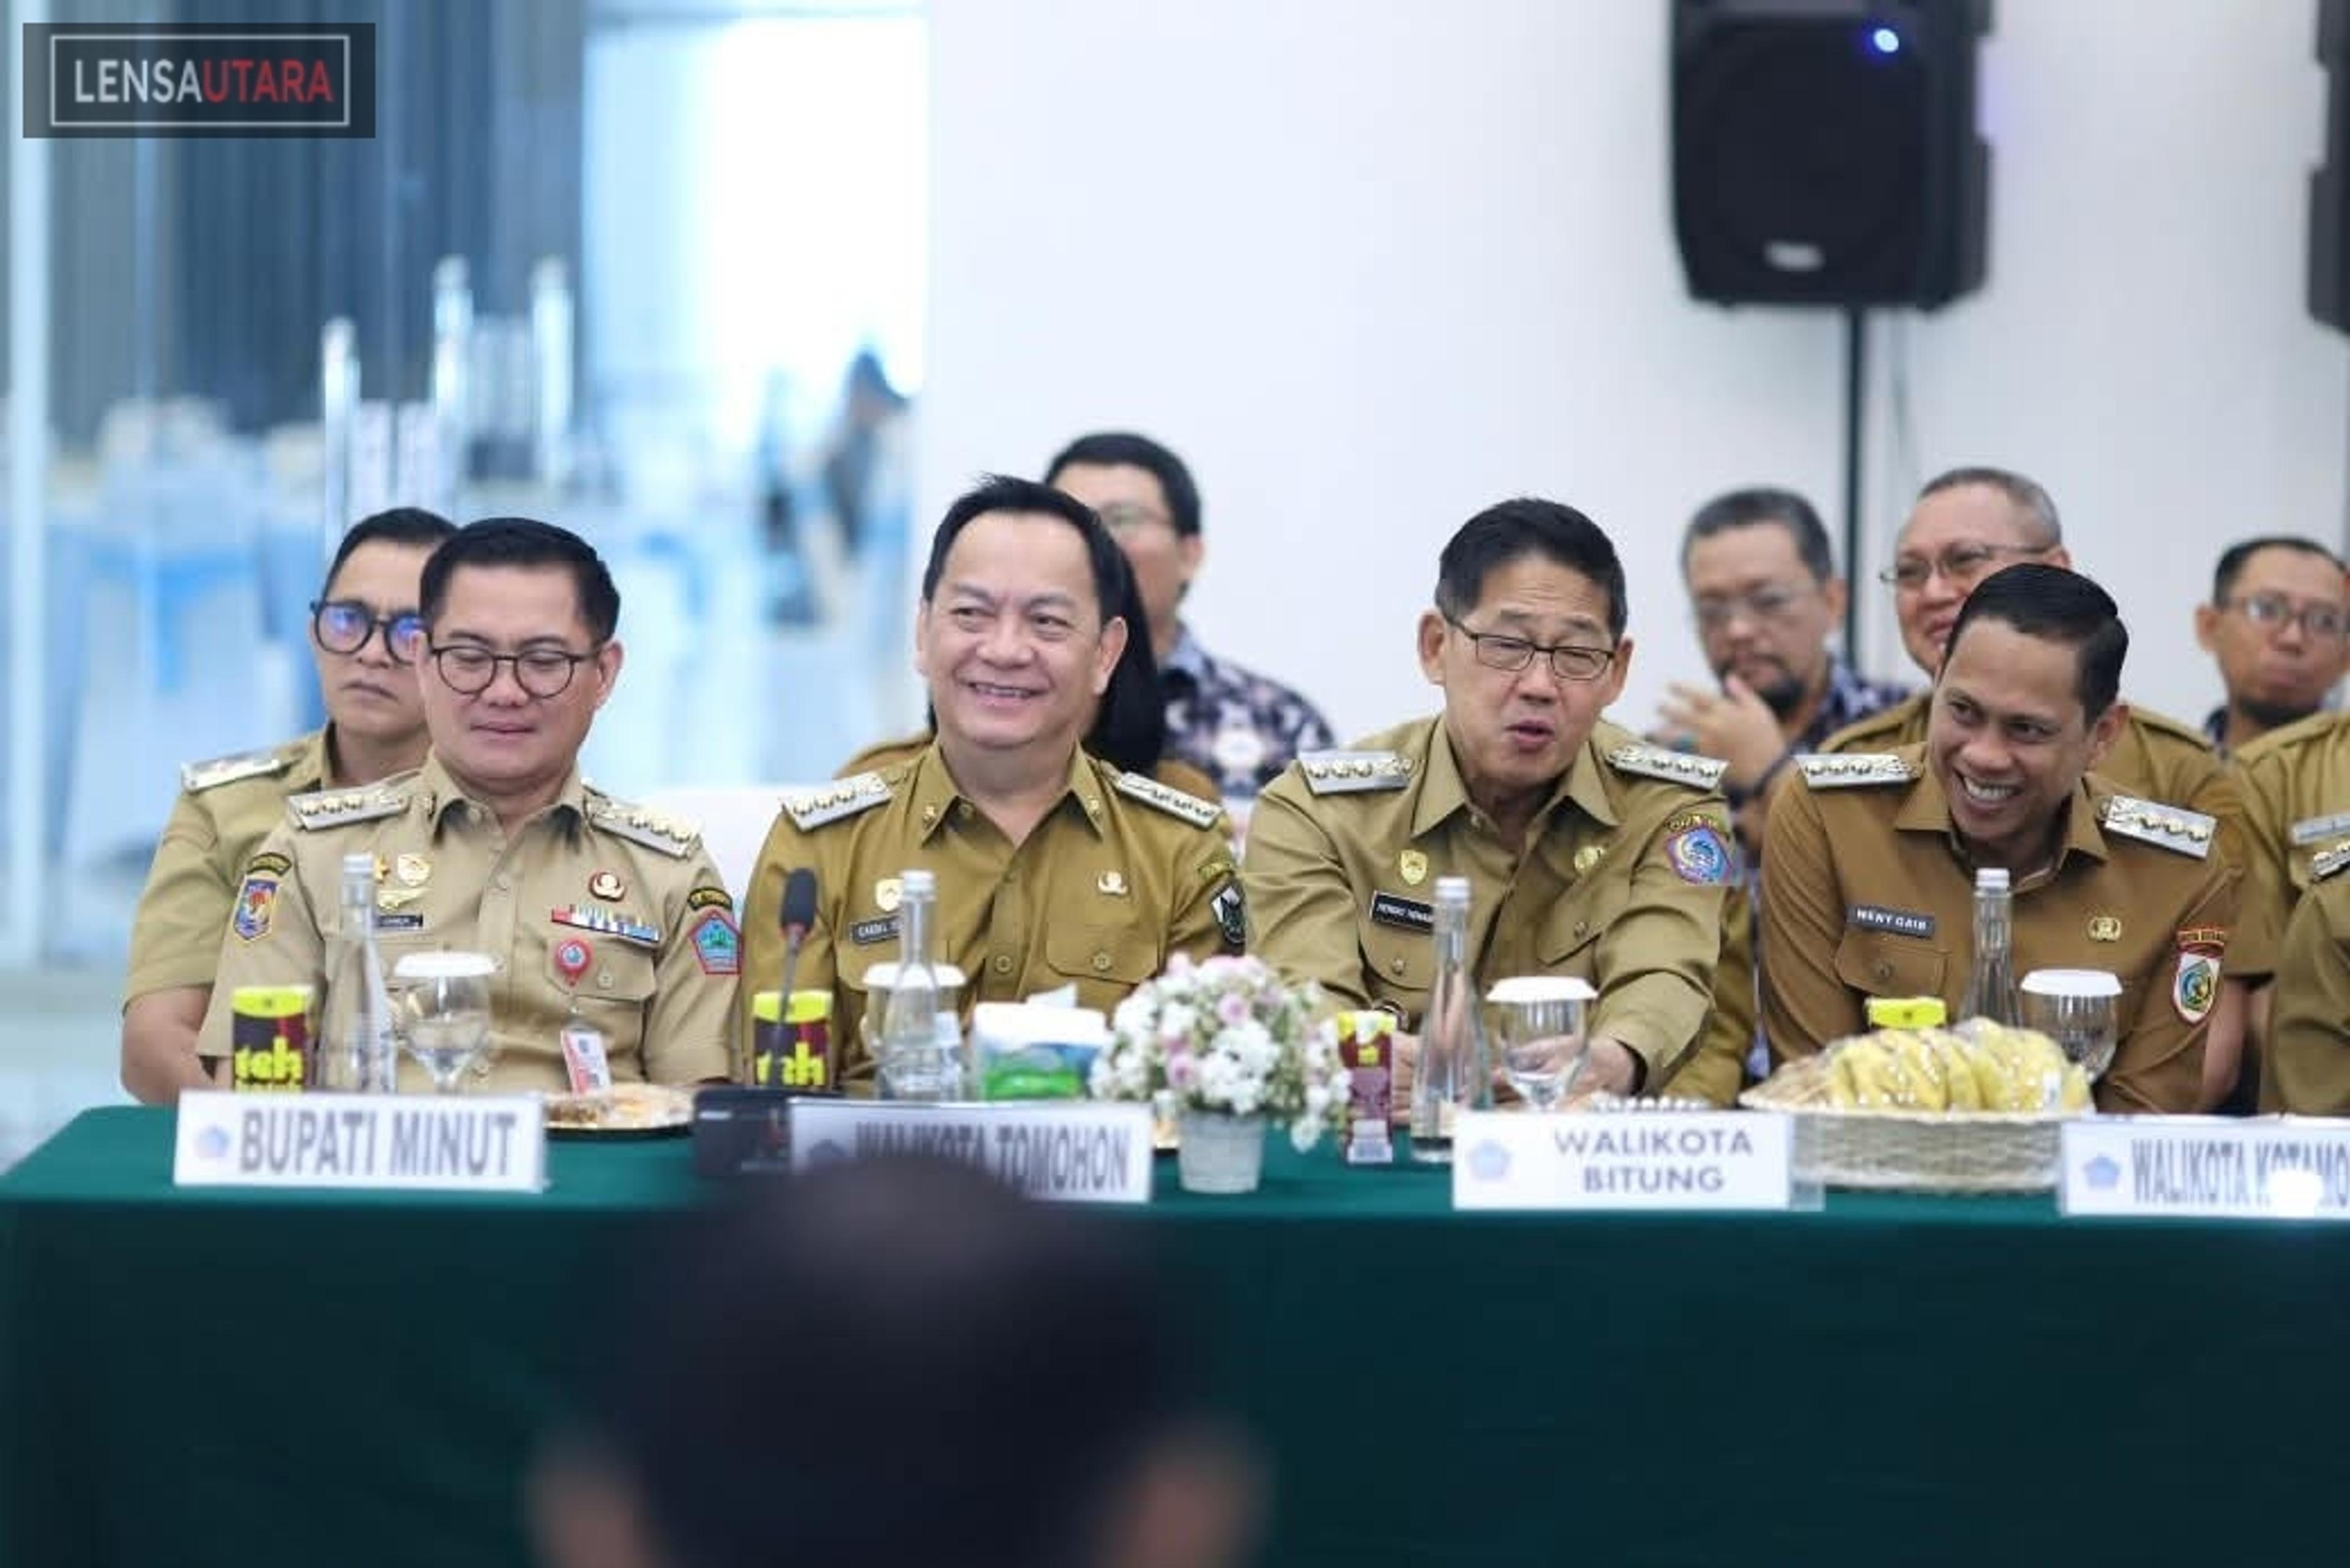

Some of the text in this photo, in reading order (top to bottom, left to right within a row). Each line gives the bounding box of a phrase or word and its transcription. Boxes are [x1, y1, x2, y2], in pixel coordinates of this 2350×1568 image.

[235, 1036, 303, 1079] teh
[239, 1110, 517, 1176] BUPATI MINUT
[995, 1124, 1130, 1191] TOMOHON
[1553, 1127, 1754, 1155] WALIKOTA
[1583, 1166, 1725, 1193] BITUNG
[2132, 1139, 2250, 1204] WALIKOTA
